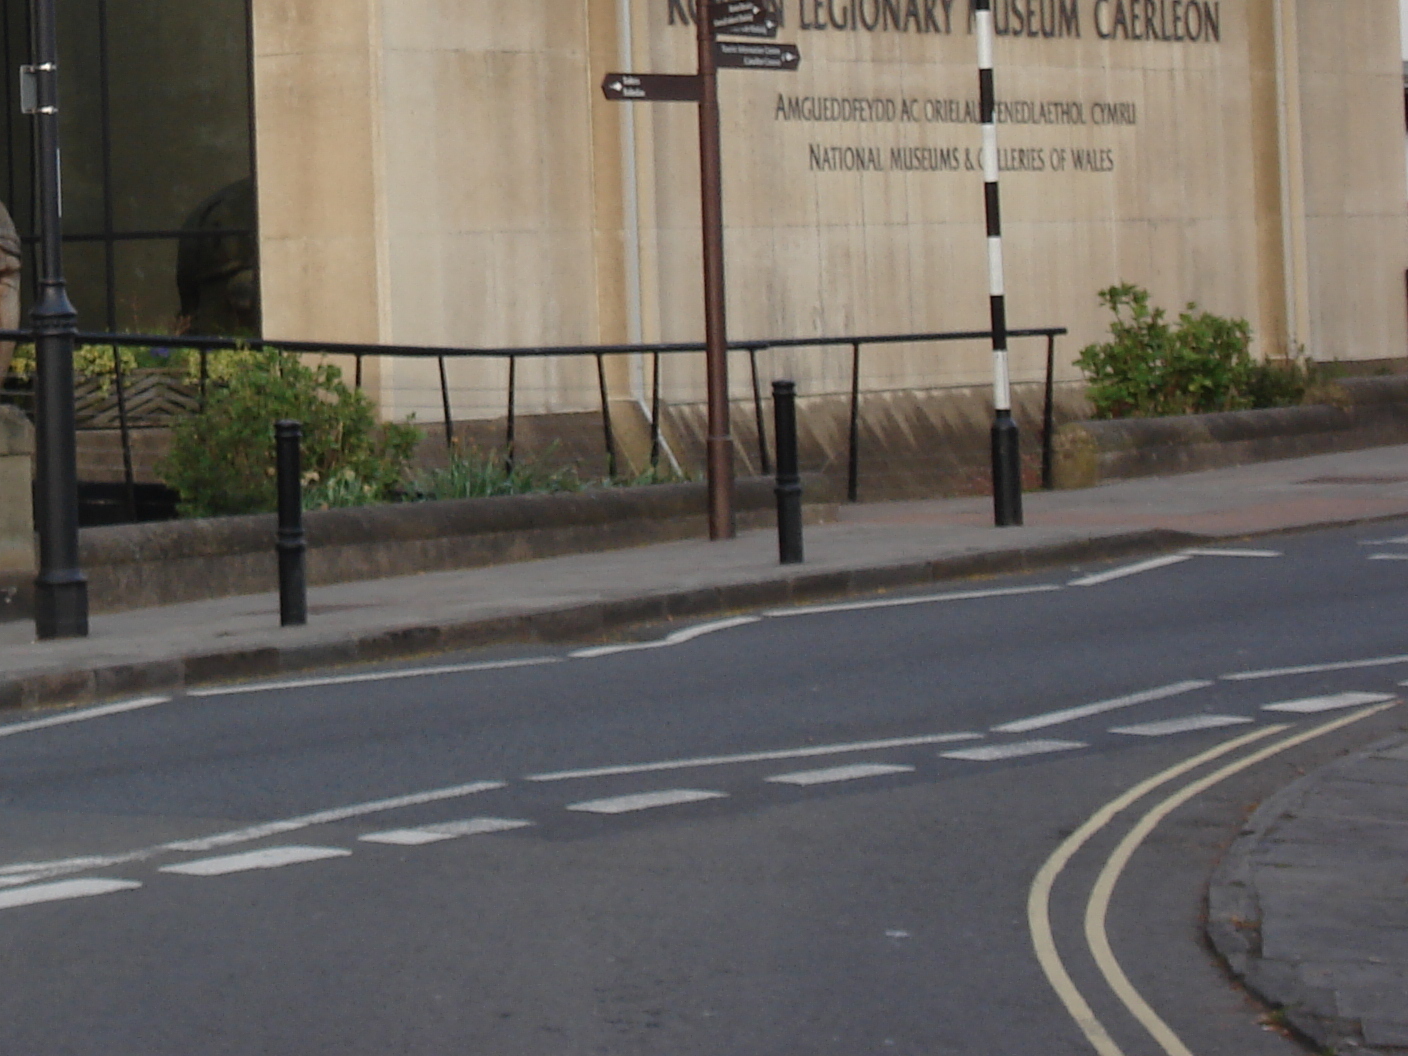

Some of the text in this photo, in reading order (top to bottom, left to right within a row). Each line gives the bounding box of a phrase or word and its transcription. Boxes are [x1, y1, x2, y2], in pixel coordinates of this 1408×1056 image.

[775, 93, 896, 122] AMGUEDDFEYDD
[900, 98, 920, 123] AC
[992, 100, 1087, 125] ENEDLAETHOL
[1091, 102, 1136, 125] CYMRU
[809, 143, 1114, 172] NATIONAL MUSEUMS & LLERIES OF WALES
